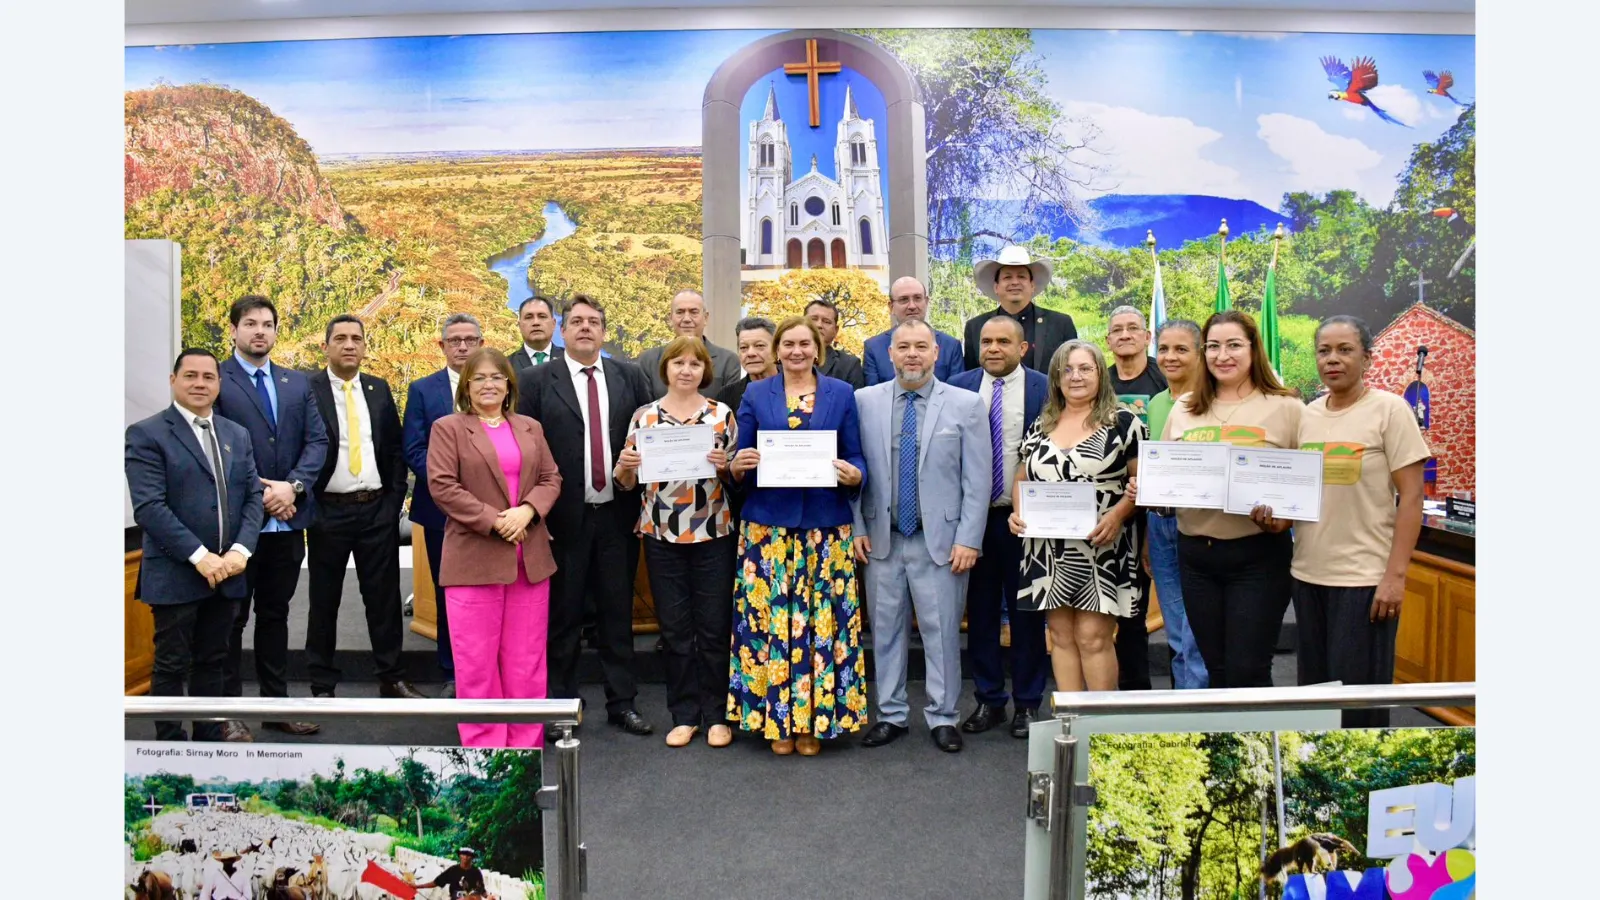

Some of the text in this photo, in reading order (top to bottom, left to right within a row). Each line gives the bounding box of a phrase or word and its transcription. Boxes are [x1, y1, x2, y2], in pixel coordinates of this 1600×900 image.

[1107, 741, 1155, 750] Fotografia:
[136, 748, 183, 757] Fotografia:
[186, 749, 213, 759] Sirnay
[246, 750, 254, 758] In
[257, 750, 302, 758] Memoriam
[1367, 776, 1476, 859] EU
